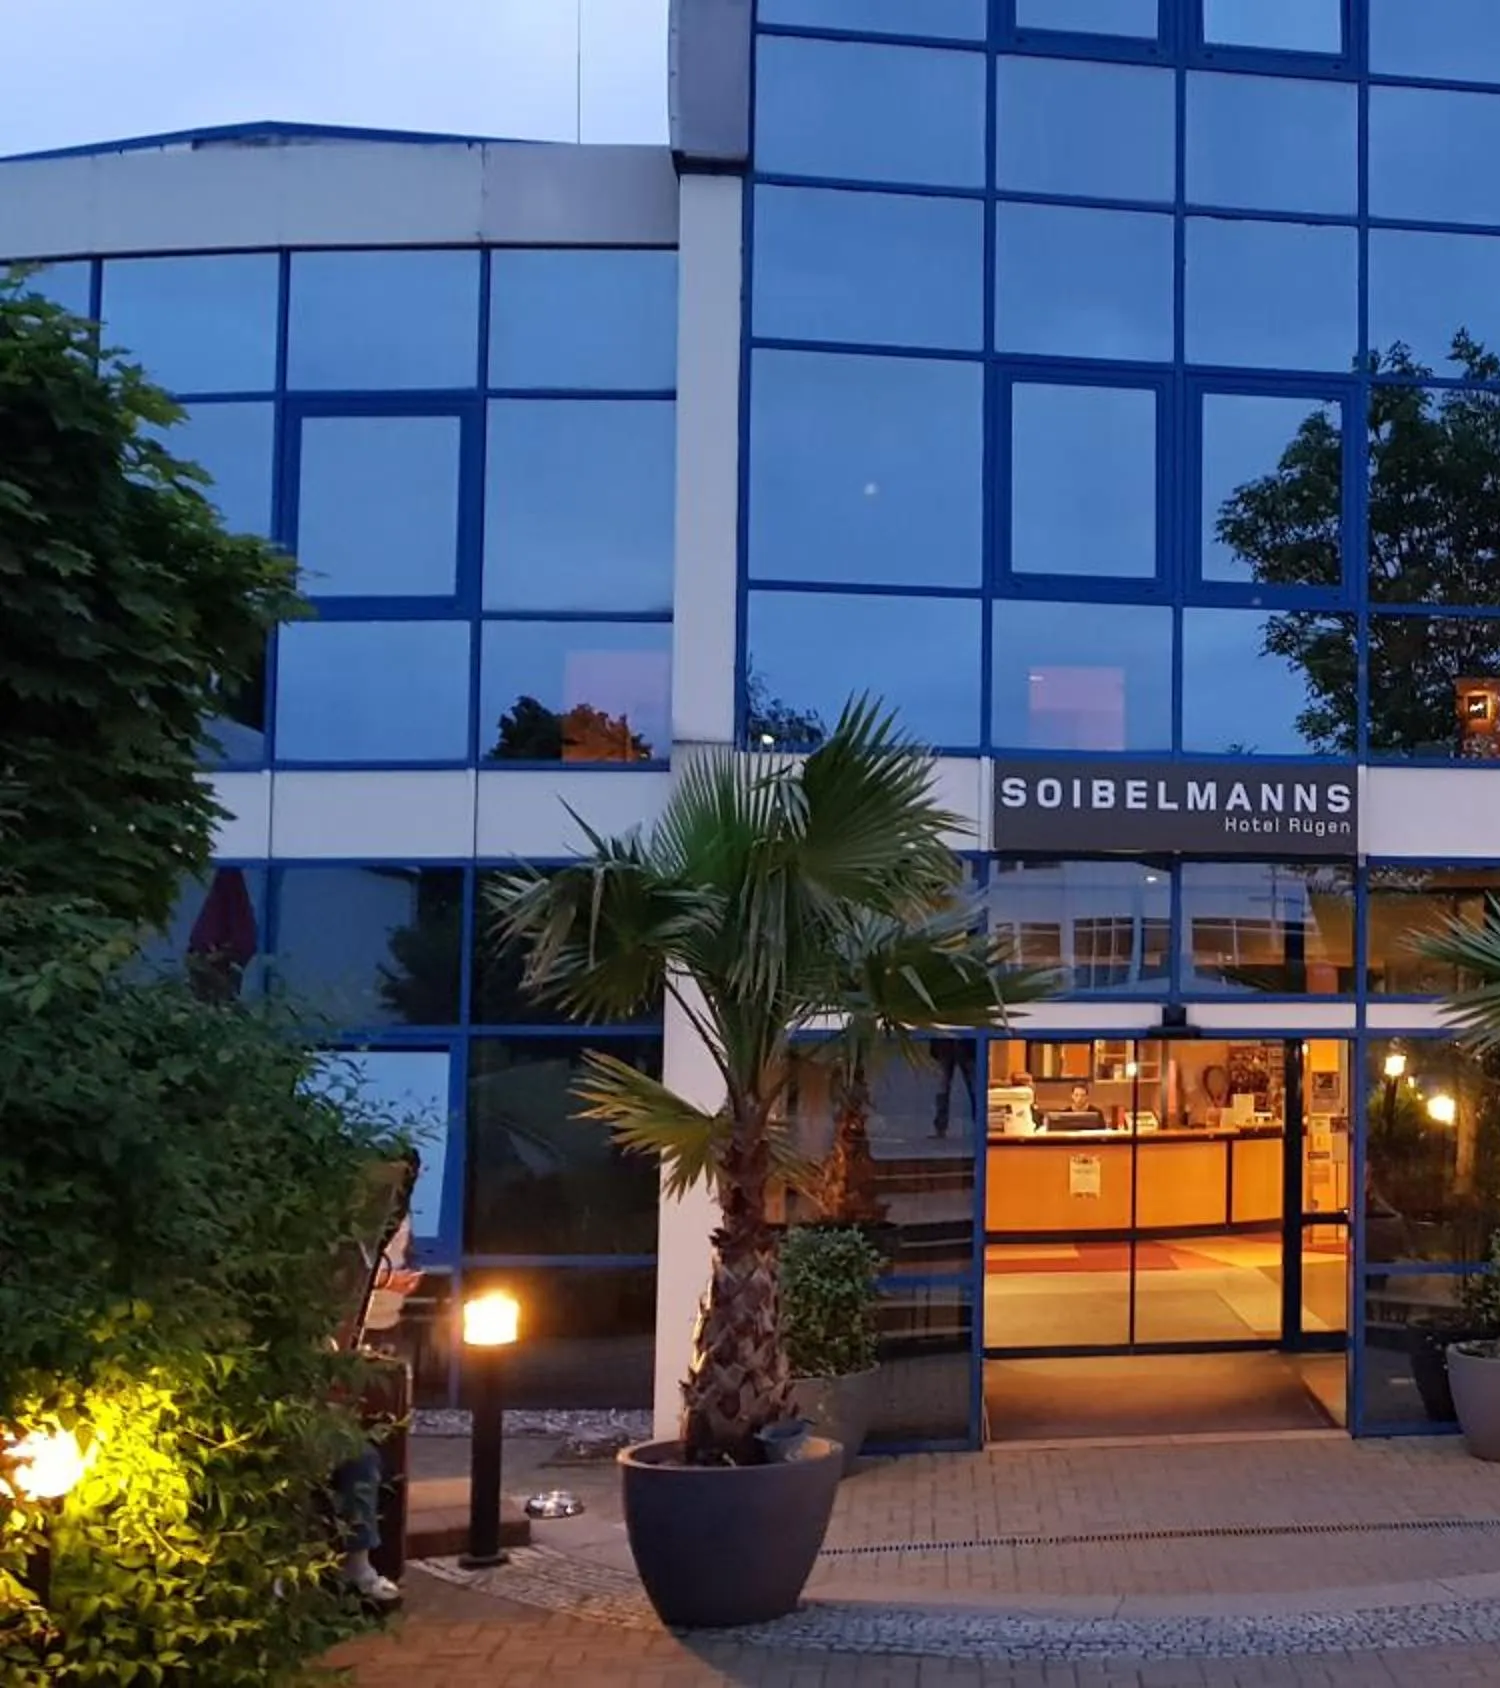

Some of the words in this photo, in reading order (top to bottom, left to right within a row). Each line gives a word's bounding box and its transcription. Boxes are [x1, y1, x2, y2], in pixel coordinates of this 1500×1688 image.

[1001, 777, 1351, 813] SOIBELMANNS
[1225, 817, 1279, 833] Hotel
[1288, 817, 1351, 837] Rügen
